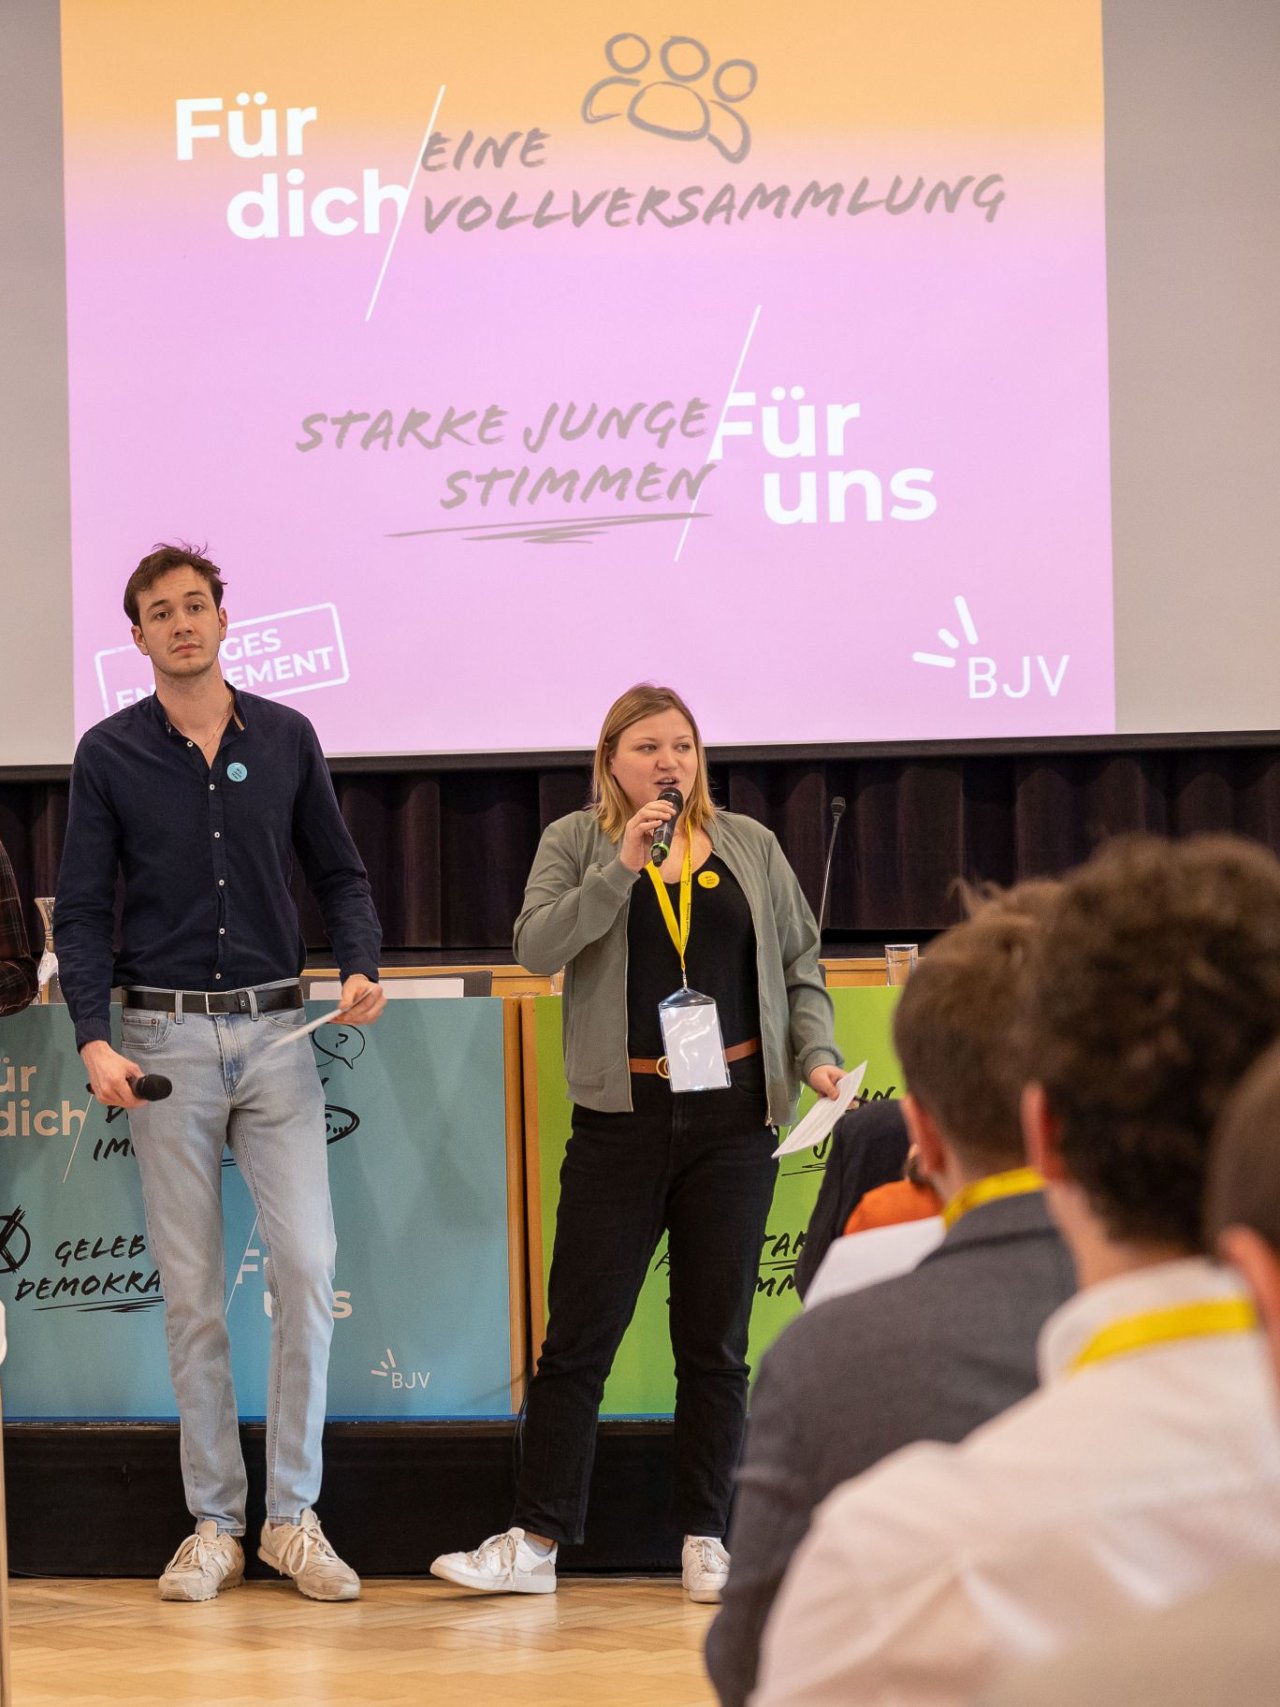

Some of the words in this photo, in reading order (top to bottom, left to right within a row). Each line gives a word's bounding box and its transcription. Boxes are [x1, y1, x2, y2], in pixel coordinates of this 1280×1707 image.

[176, 92, 317, 160] Für
[421, 128, 551, 172] EINE
[227, 168, 409, 240] dich
[424, 173, 1005, 234] VOLLVERSAMMLUNG
[296, 404, 510, 453] STARKE
[523, 397, 711, 453] JUNGE
[708, 385, 860, 460] Für
[440, 462, 718, 510] STIMMEN
[764, 467, 937, 525] uns
[968, 654, 1071, 699] BJV
[54, 1234, 147, 1268] GELEB
[15, 1269, 163, 1301] DEMOKRA
[392, 1371, 430, 1389] BJV
